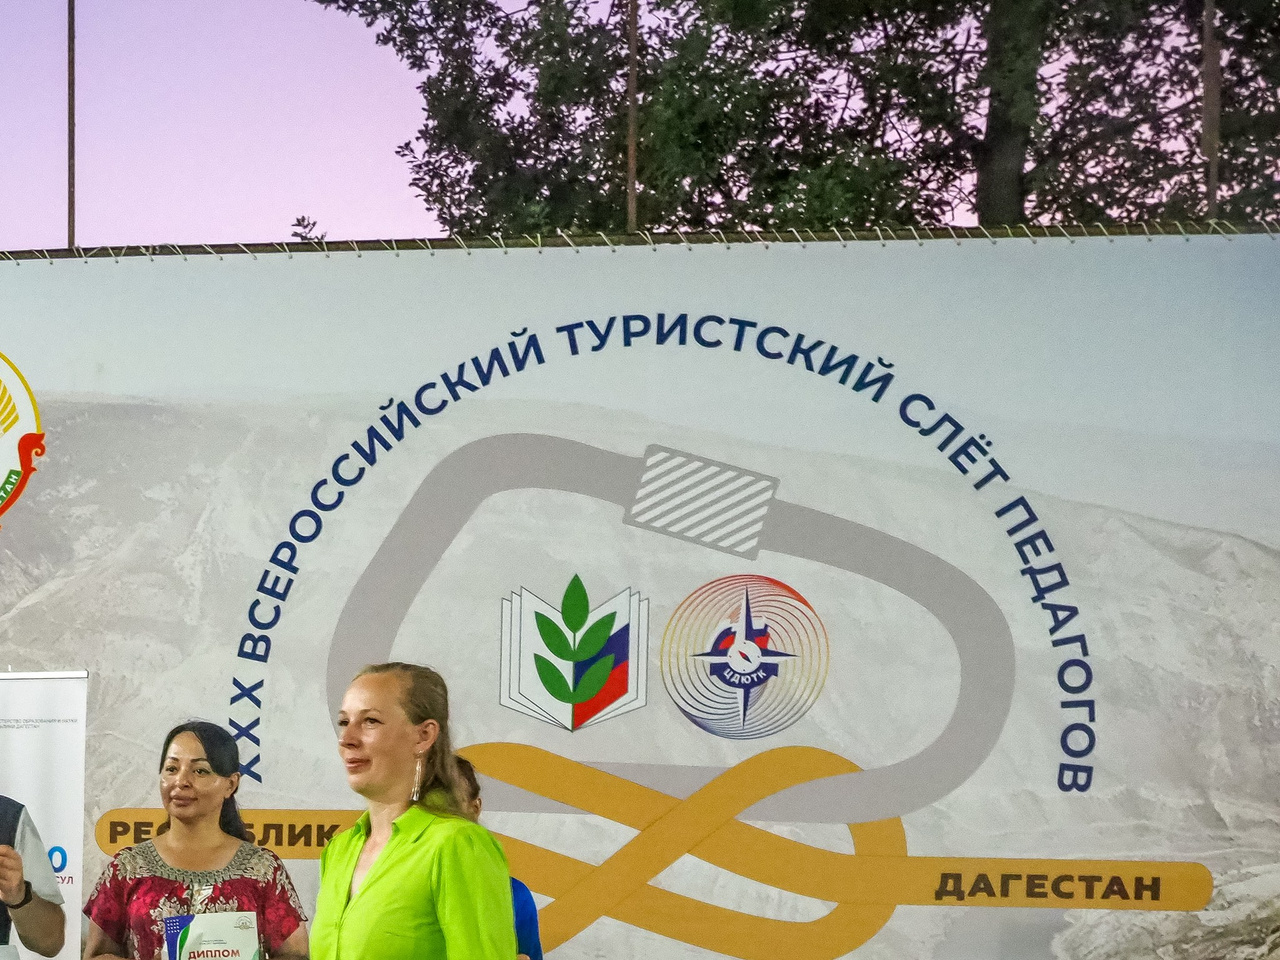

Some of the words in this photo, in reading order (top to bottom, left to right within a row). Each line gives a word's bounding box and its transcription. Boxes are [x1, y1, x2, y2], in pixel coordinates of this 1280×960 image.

[237, 326, 546, 663] ВСЕРОССИЙСКИЙ
[556, 312, 896, 403] ТУРИСТСКИЙ
[898, 393, 1011, 491] СЛЁТ
[993, 495, 1096, 793] ПЕДАГОГОВ
[934, 872, 1161, 901] ДАГЕСТАН
[188, 949, 241, 960] ДИПЛОМ
